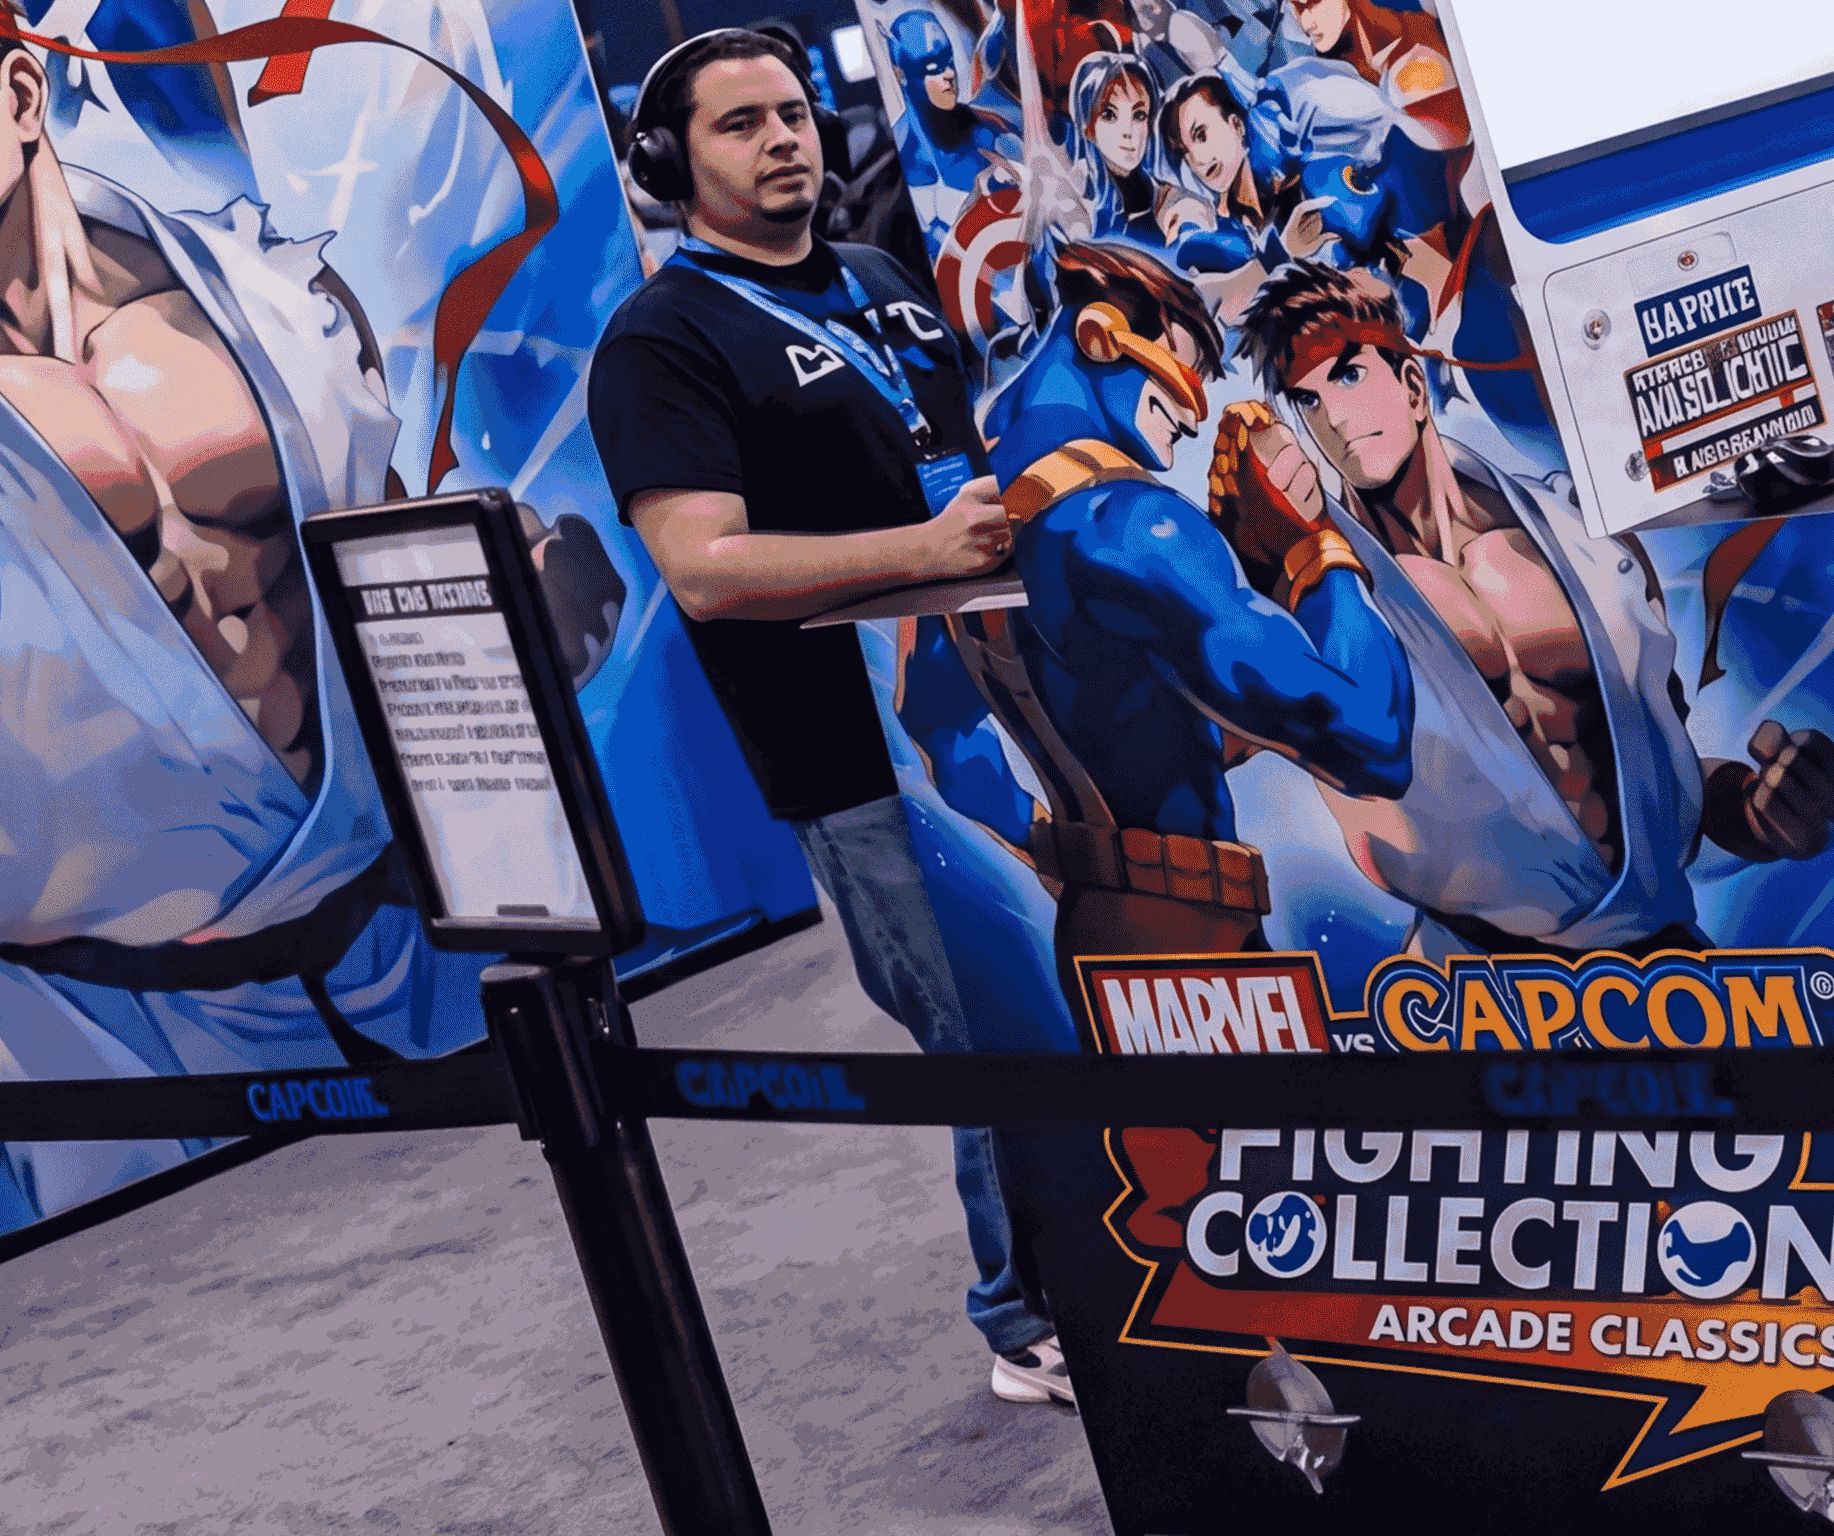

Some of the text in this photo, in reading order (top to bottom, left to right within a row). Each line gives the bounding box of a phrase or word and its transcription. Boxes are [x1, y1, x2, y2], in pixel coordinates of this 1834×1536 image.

[1103, 974, 1324, 1054] MARVEL
[1383, 974, 1813, 1052] CAPCOM
[1368, 1304, 1571, 1353] ARCADE
